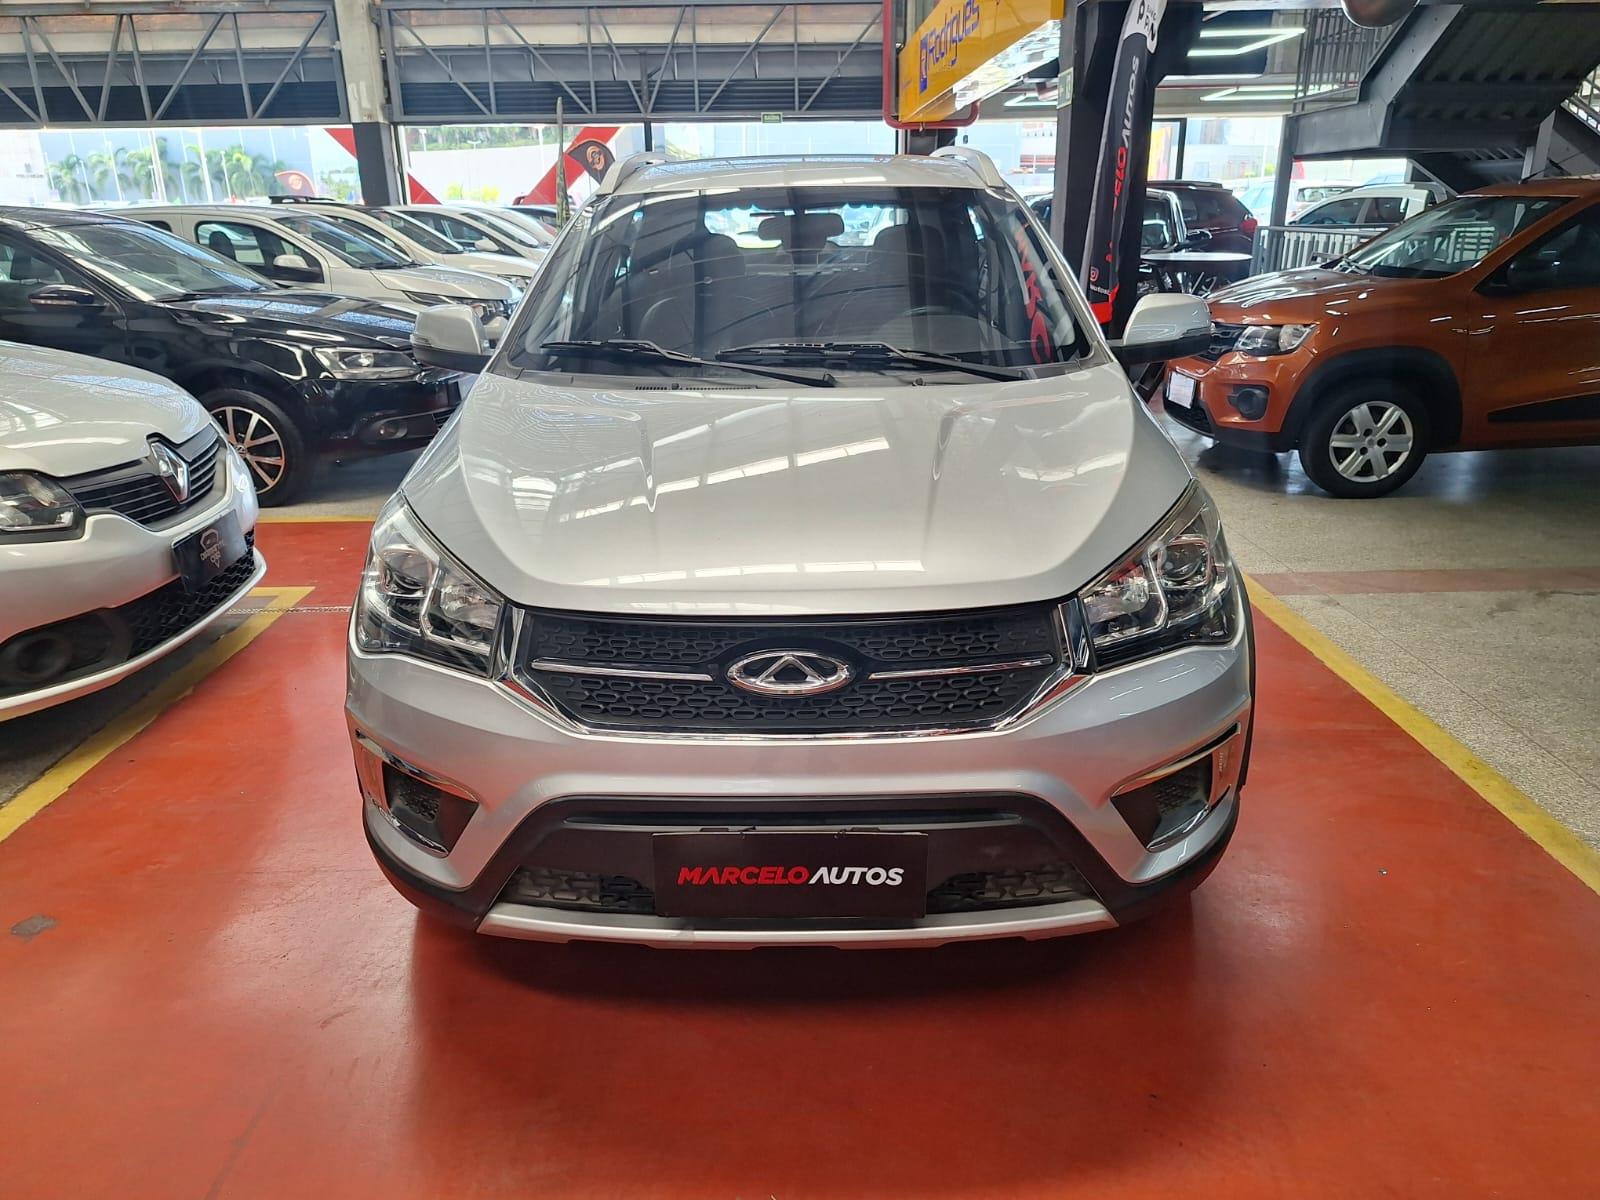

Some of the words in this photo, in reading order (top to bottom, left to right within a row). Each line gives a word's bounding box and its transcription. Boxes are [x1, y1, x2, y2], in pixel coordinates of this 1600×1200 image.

[1123, 55, 1140, 149] AUTOS
[678, 866, 808, 885] MARCELO
[808, 866, 905, 886] AUTOS
